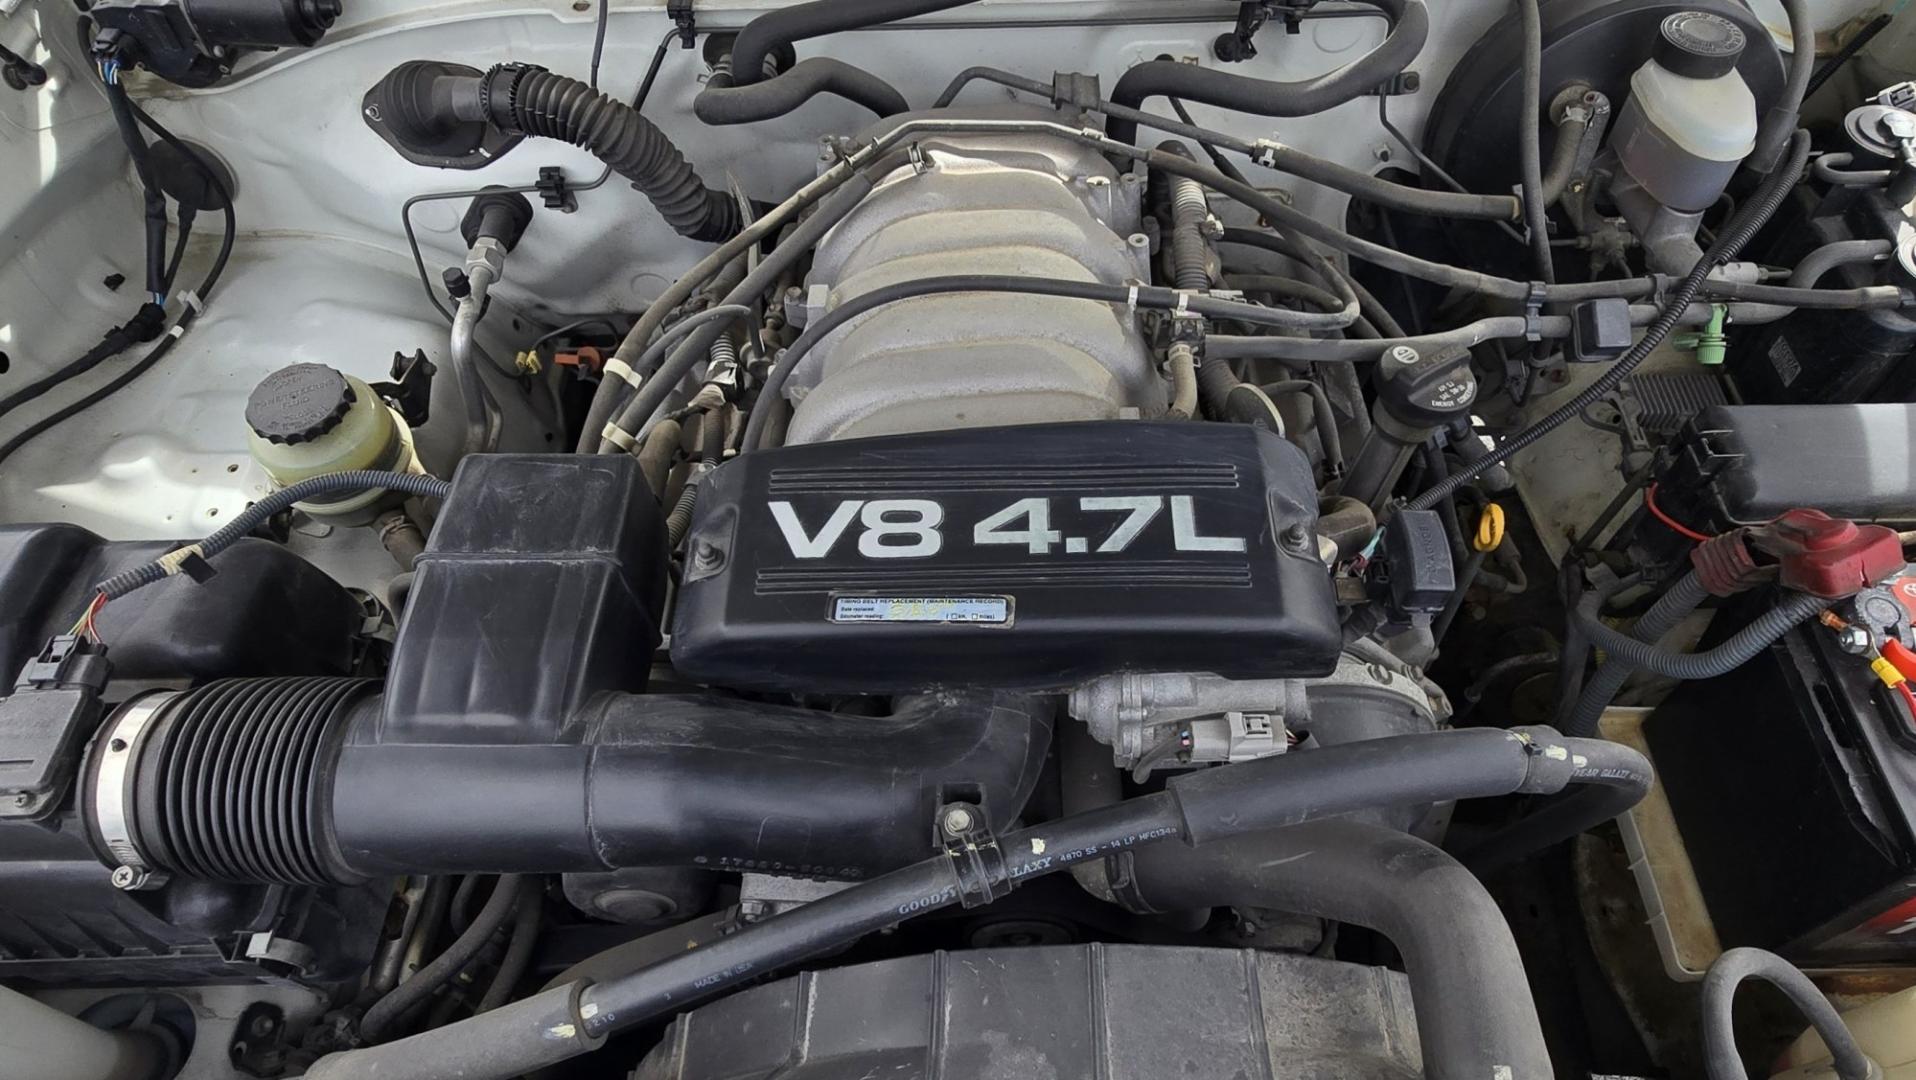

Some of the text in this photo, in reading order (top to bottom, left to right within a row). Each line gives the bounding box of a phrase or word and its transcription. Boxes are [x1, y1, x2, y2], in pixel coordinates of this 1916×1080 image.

[767, 495, 1246, 558] V8 4.7L
[694, 974, 720, 989] MADE
